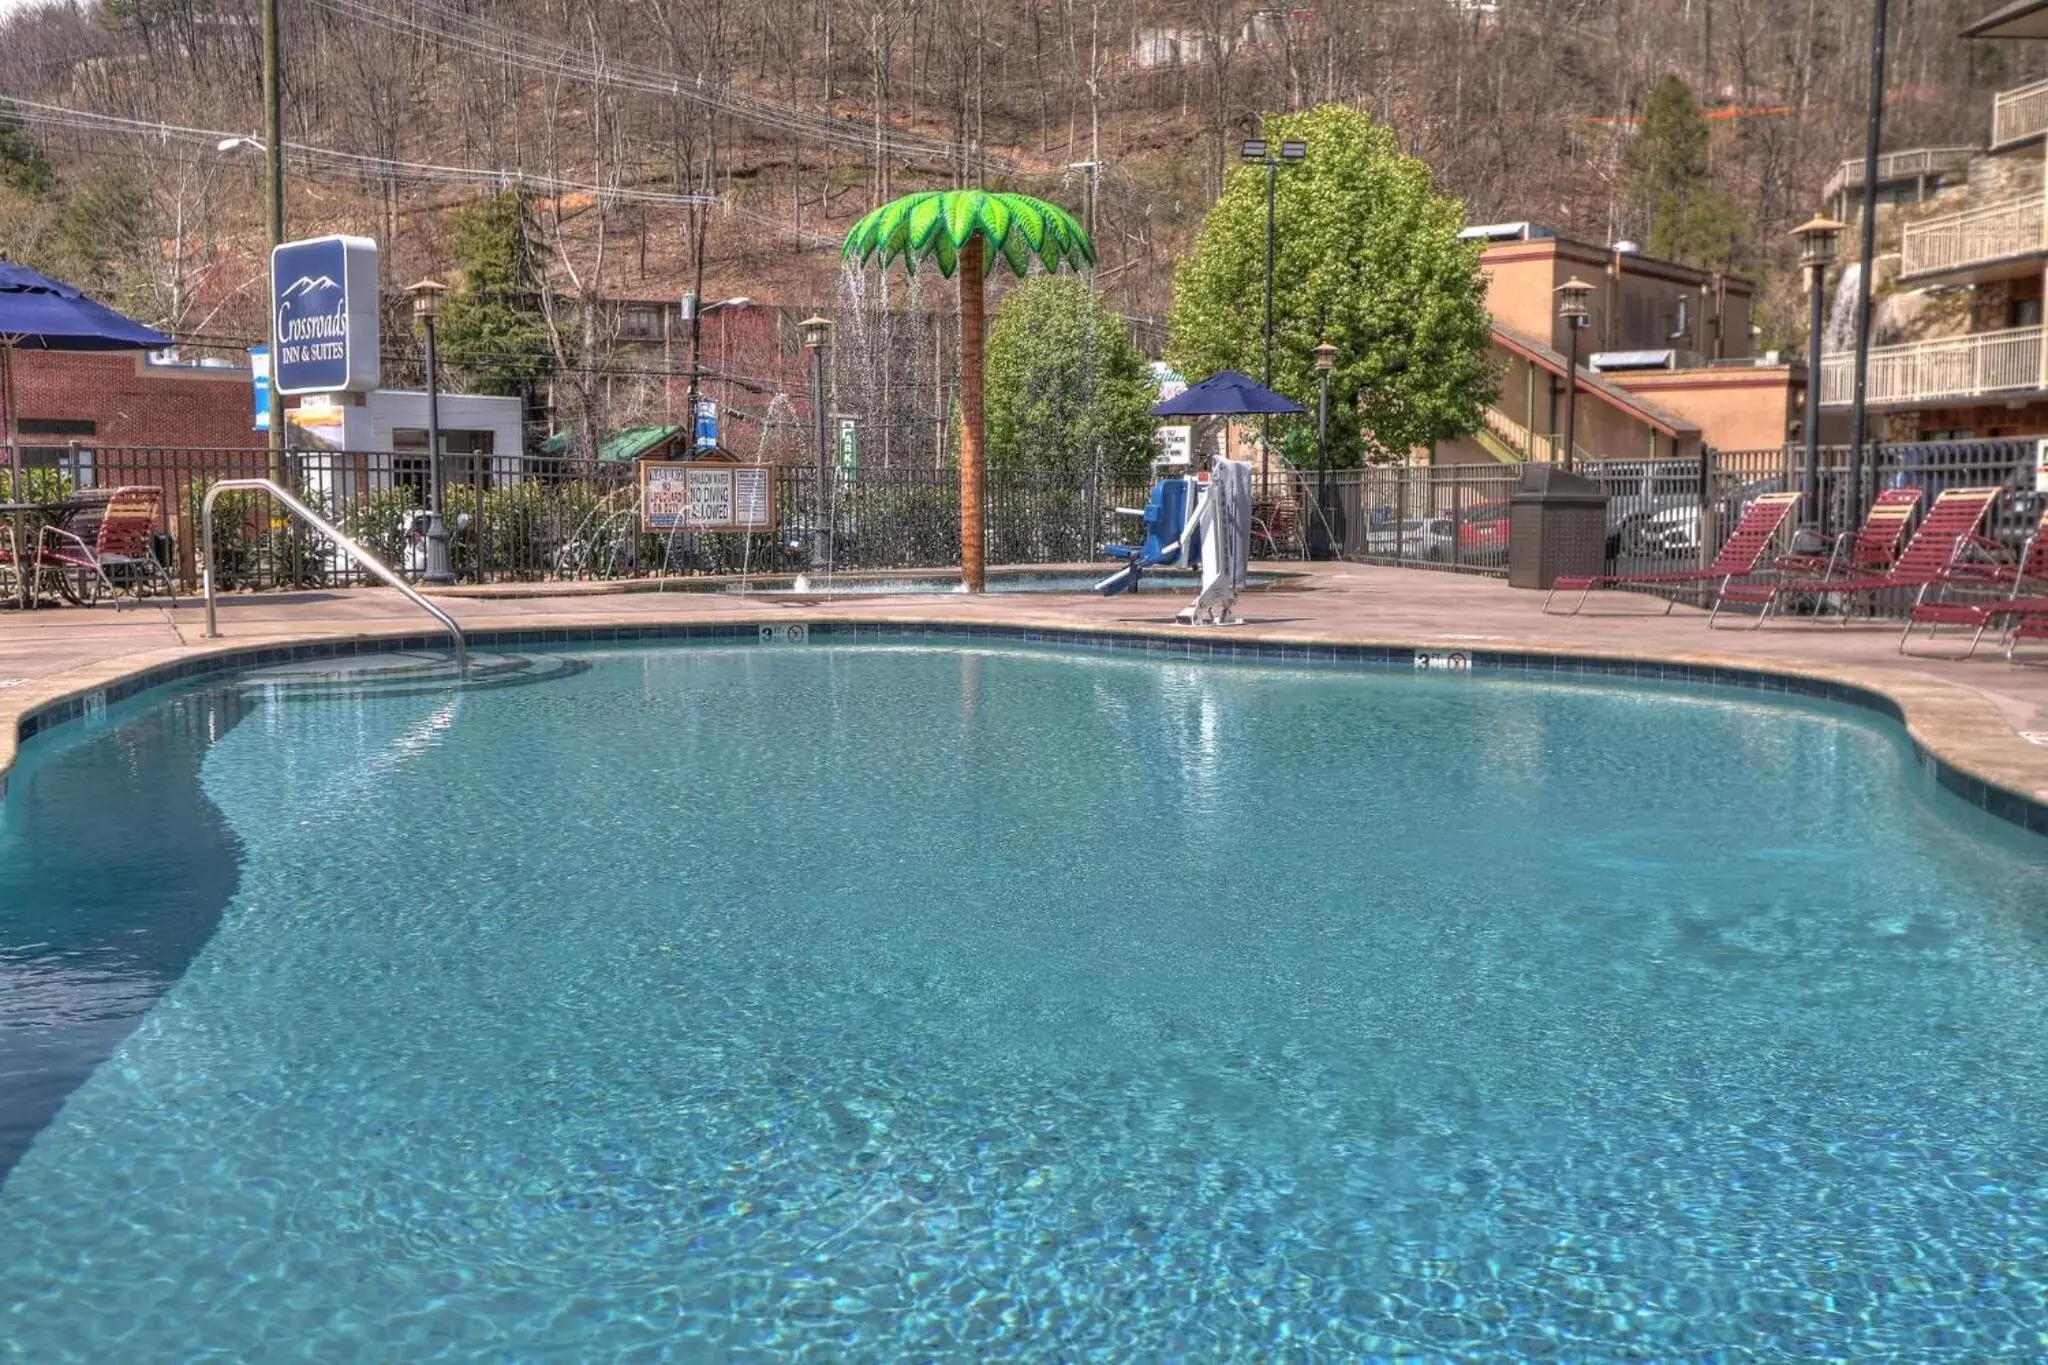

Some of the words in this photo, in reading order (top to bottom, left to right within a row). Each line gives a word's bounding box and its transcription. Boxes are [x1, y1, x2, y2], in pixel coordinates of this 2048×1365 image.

[278, 298, 347, 343] Crossroads
[283, 346, 300, 364] INN
[301, 345, 311, 362] &
[311, 342, 344, 360] SUITES
[690, 487, 701, 503] NO
[704, 487, 729, 503] DIVING
